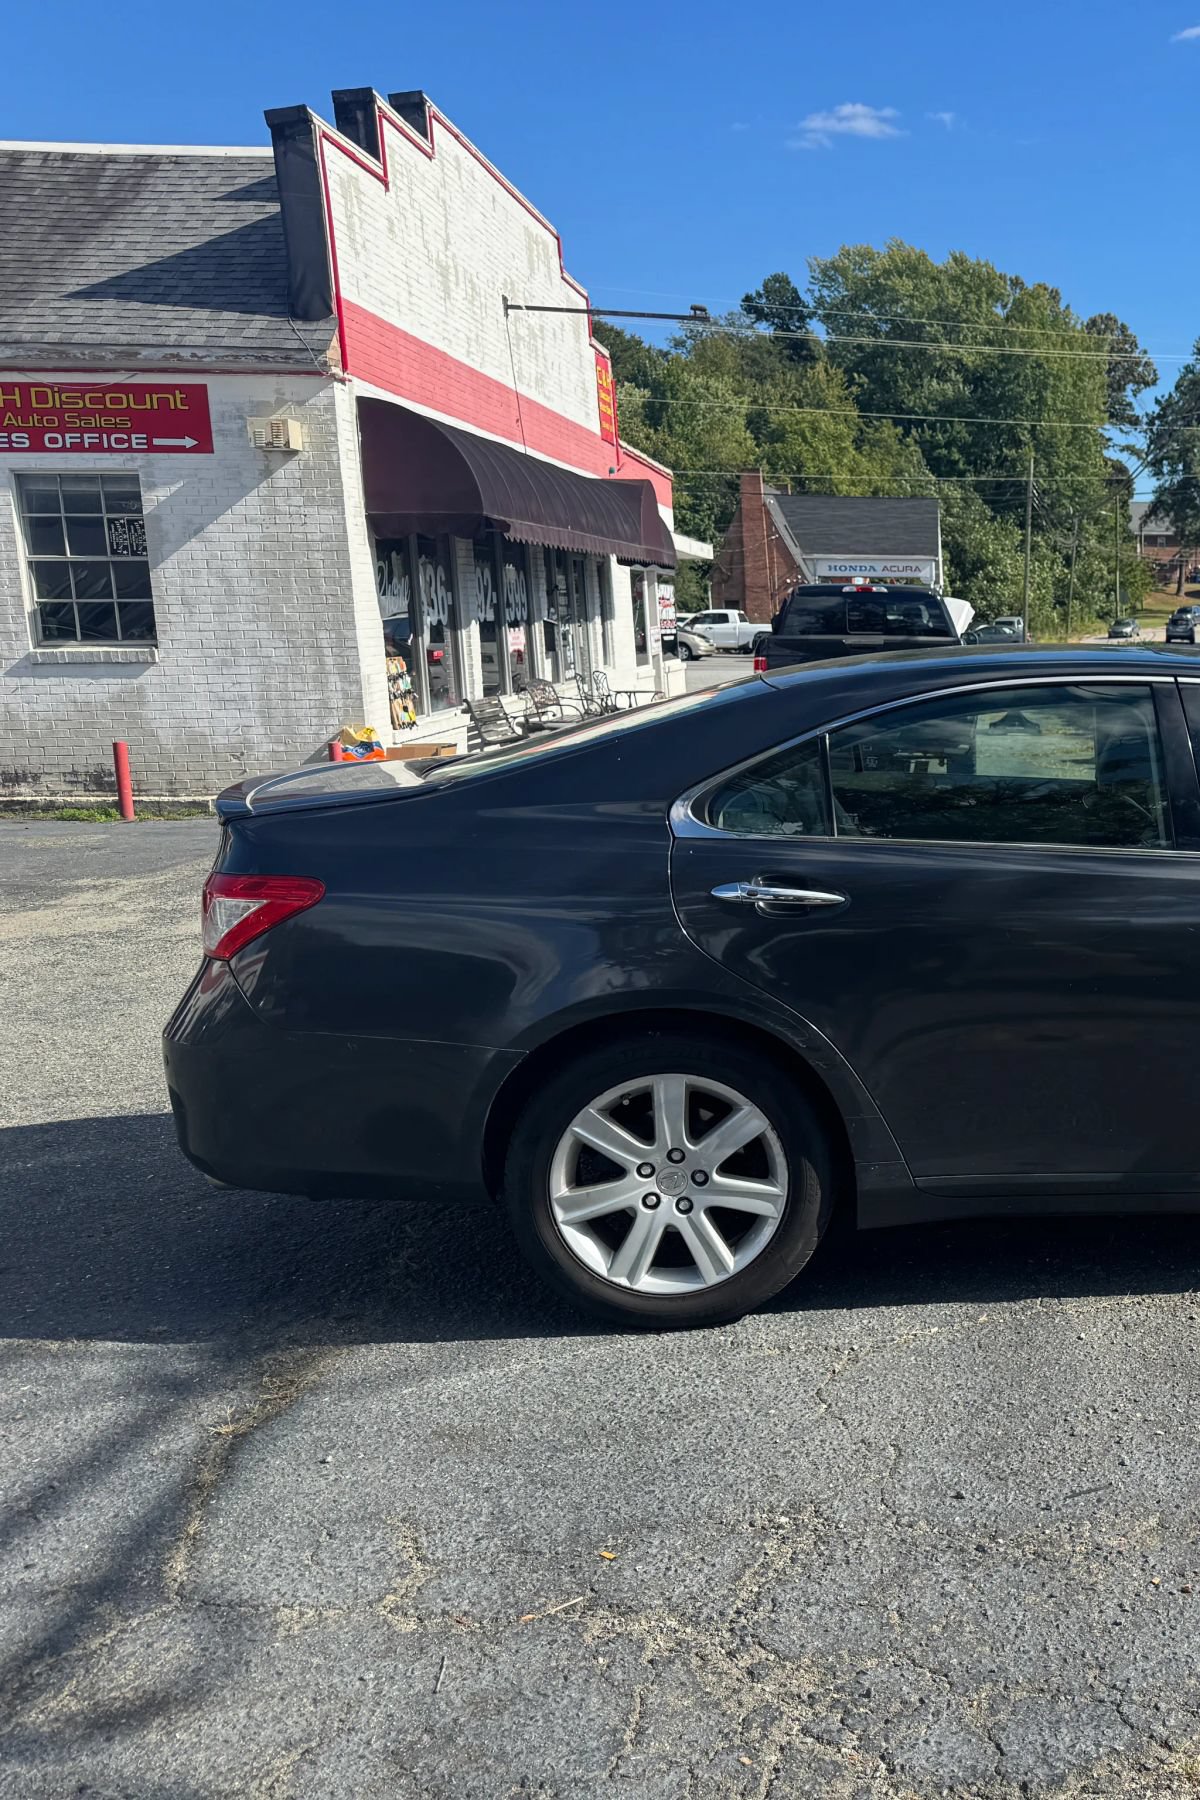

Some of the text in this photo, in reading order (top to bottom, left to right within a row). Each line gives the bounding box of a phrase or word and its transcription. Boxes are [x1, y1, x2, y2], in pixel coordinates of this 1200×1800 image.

[30, 386, 190, 410] Discount
[2, 411, 132, 429] Auto Sales
[43, 432, 149, 449] OFFICE
[827, 564, 922, 573] HONDA ACURA
